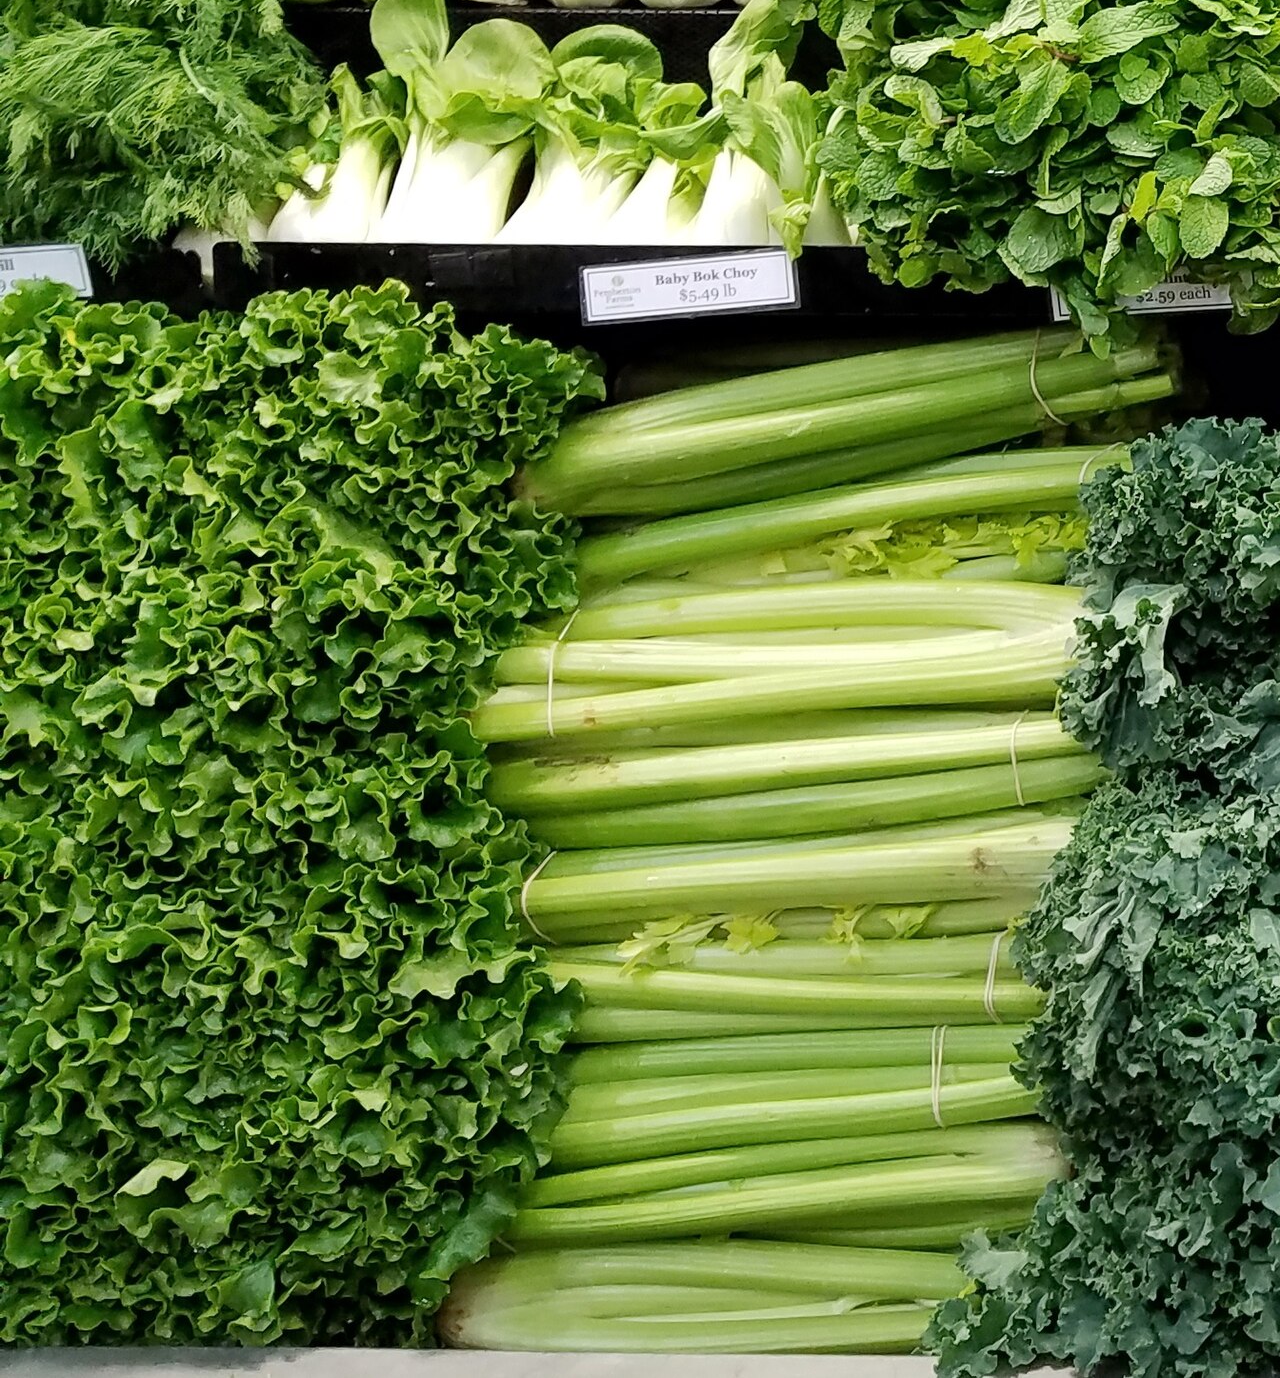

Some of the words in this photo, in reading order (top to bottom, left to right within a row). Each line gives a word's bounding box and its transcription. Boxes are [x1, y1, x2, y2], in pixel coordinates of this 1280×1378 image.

[655, 272, 690, 287] Baby
[693, 269, 720, 282] Bok
[723, 267, 758, 280] Choy
[679, 287, 719, 303] $5.49
[723, 283, 737, 297] lb
[1180, 286, 1211, 300] each
